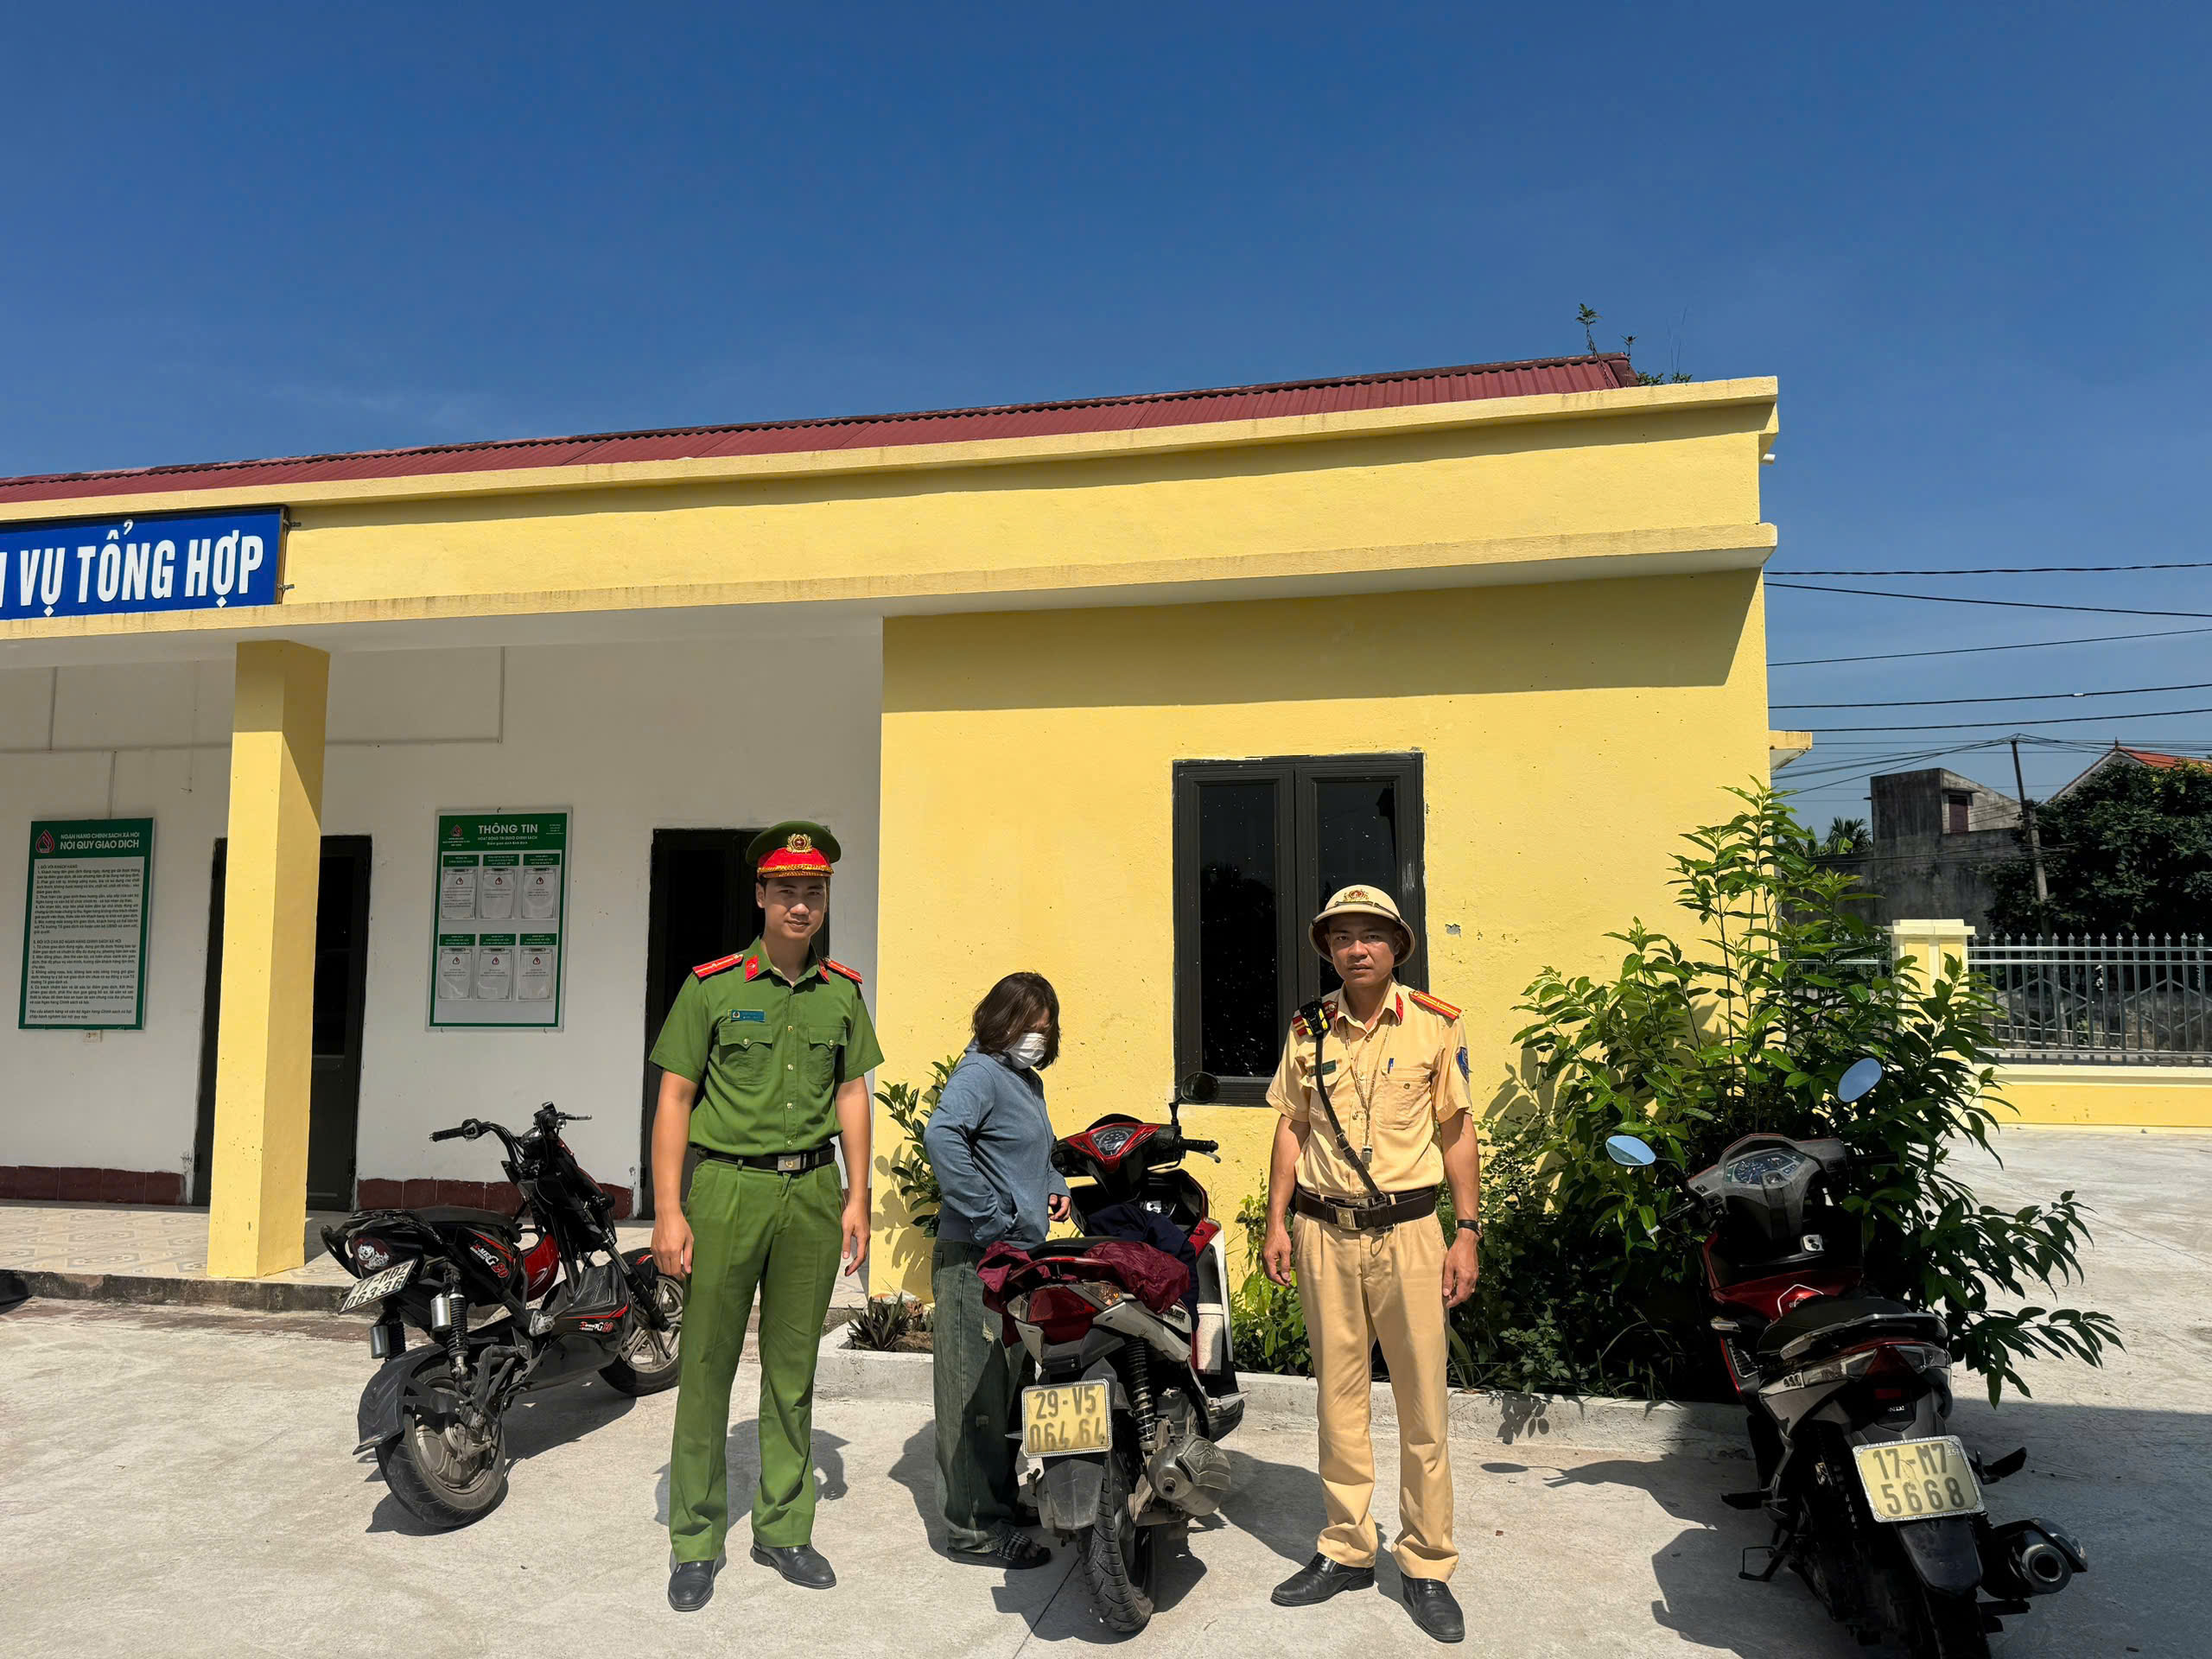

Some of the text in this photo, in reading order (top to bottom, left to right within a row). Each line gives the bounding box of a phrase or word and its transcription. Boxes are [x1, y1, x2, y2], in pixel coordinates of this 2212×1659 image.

[21, 548, 66, 617] VỤ
[77, 518, 176, 603] TỔNG
[184, 530, 264, 608] HỢP
[60, 839, 139, 850] NỘI QUY GIAO DỊCH
[478, 822, 518, 835] THÔNG
[521, 823, 538, 834] TIN
[1033, 1386, 1096, 1420] 29-V5
[1872, 1443, 1948, 1480] 17-M7
[1880, 1477, 1965, 1515] 5668
